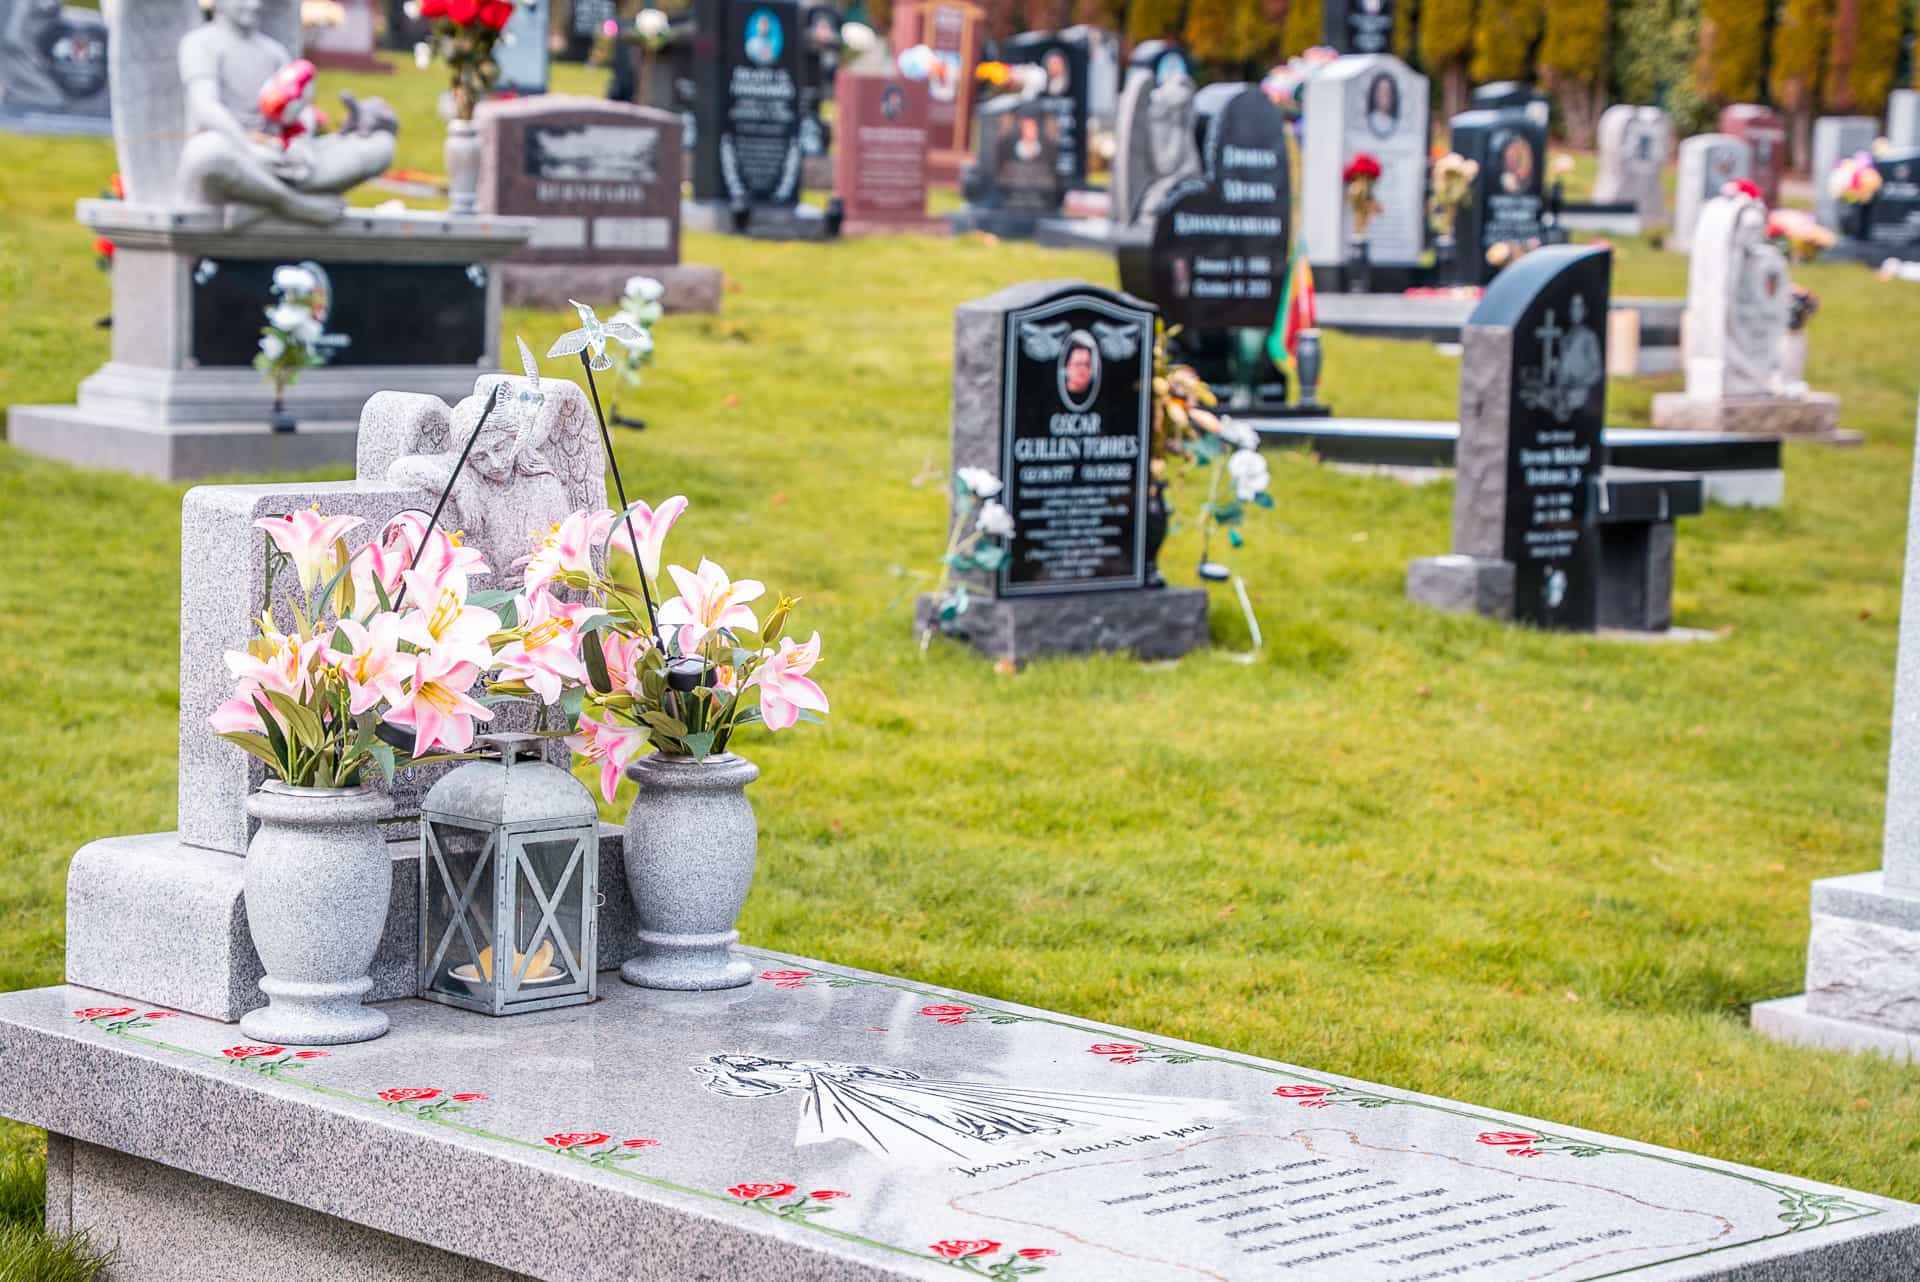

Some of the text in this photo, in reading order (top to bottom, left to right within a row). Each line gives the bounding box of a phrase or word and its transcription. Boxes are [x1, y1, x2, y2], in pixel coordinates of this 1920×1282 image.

[1050, 413, 1101, 434] OSCAR
[949, 1123, 1215, 1178] Jesus I trust in you
